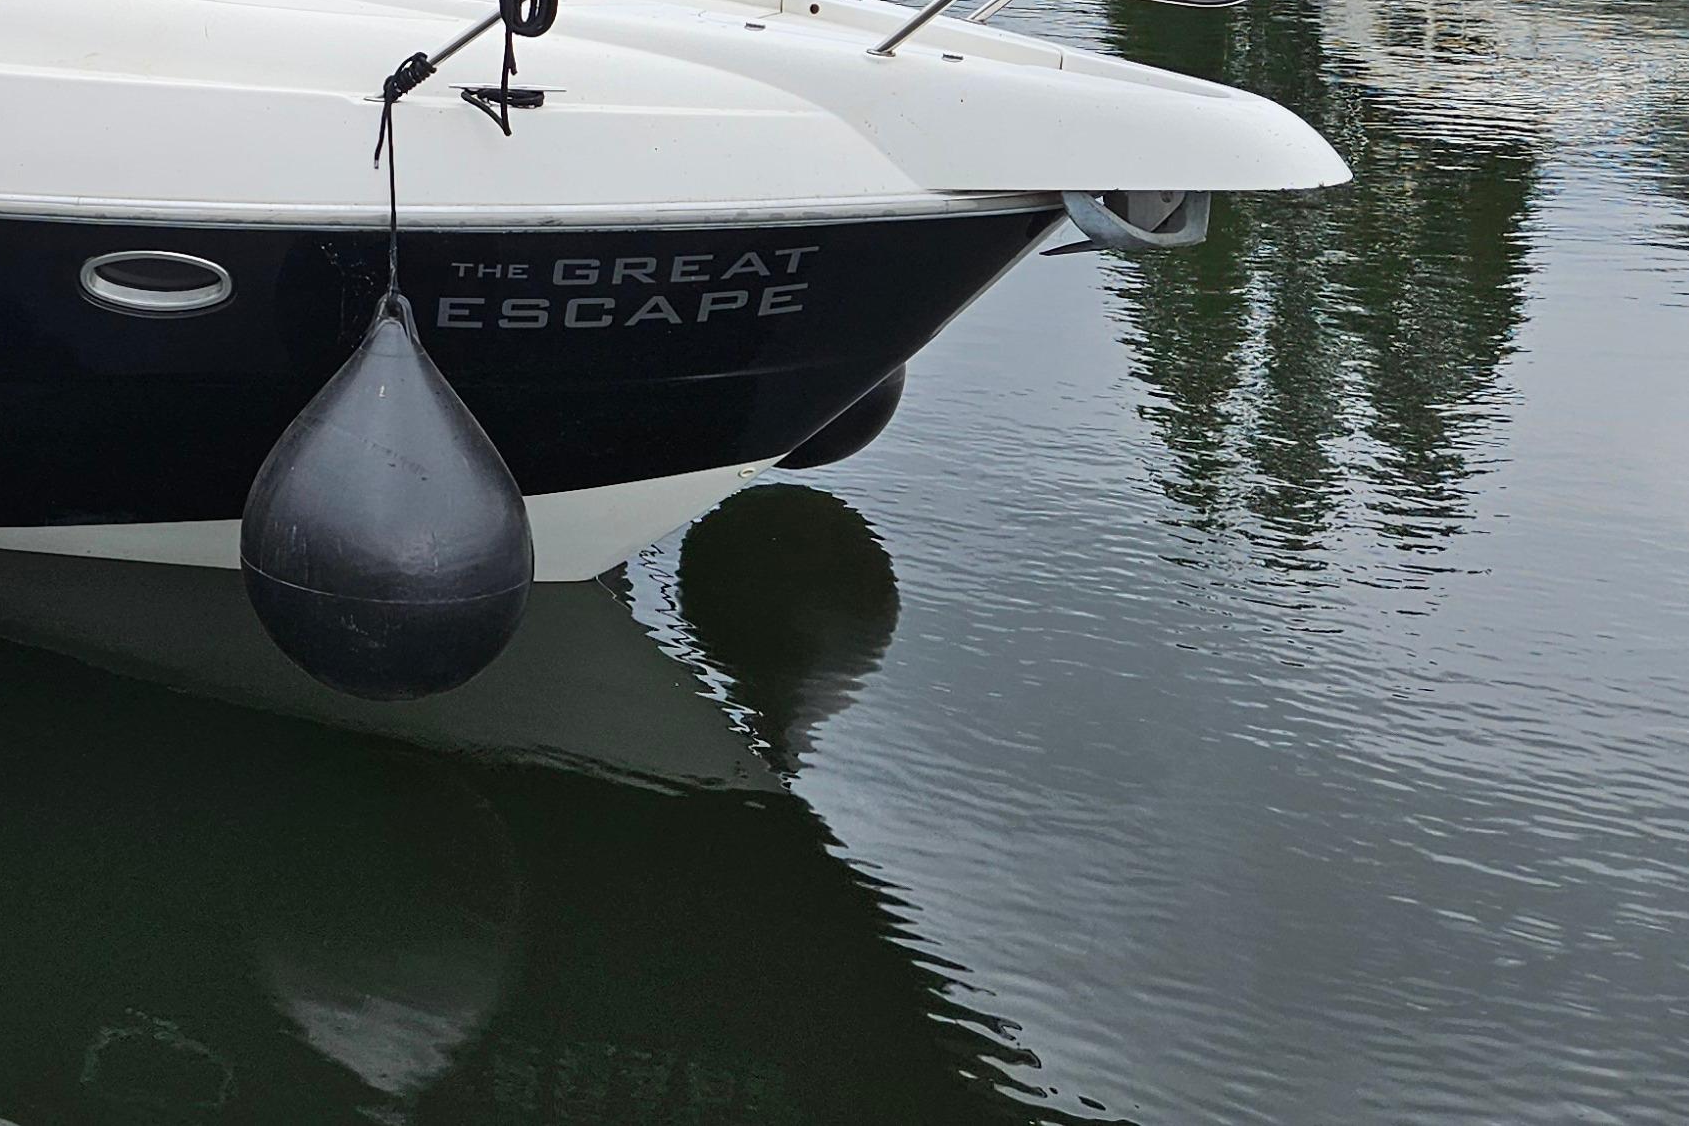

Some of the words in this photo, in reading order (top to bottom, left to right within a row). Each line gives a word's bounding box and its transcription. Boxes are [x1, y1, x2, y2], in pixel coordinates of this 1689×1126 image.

[451, 262, 530, 279] THE
[552, 246, 820, 286] GREAT
[437, 282, 809, 329] ESCAPE
